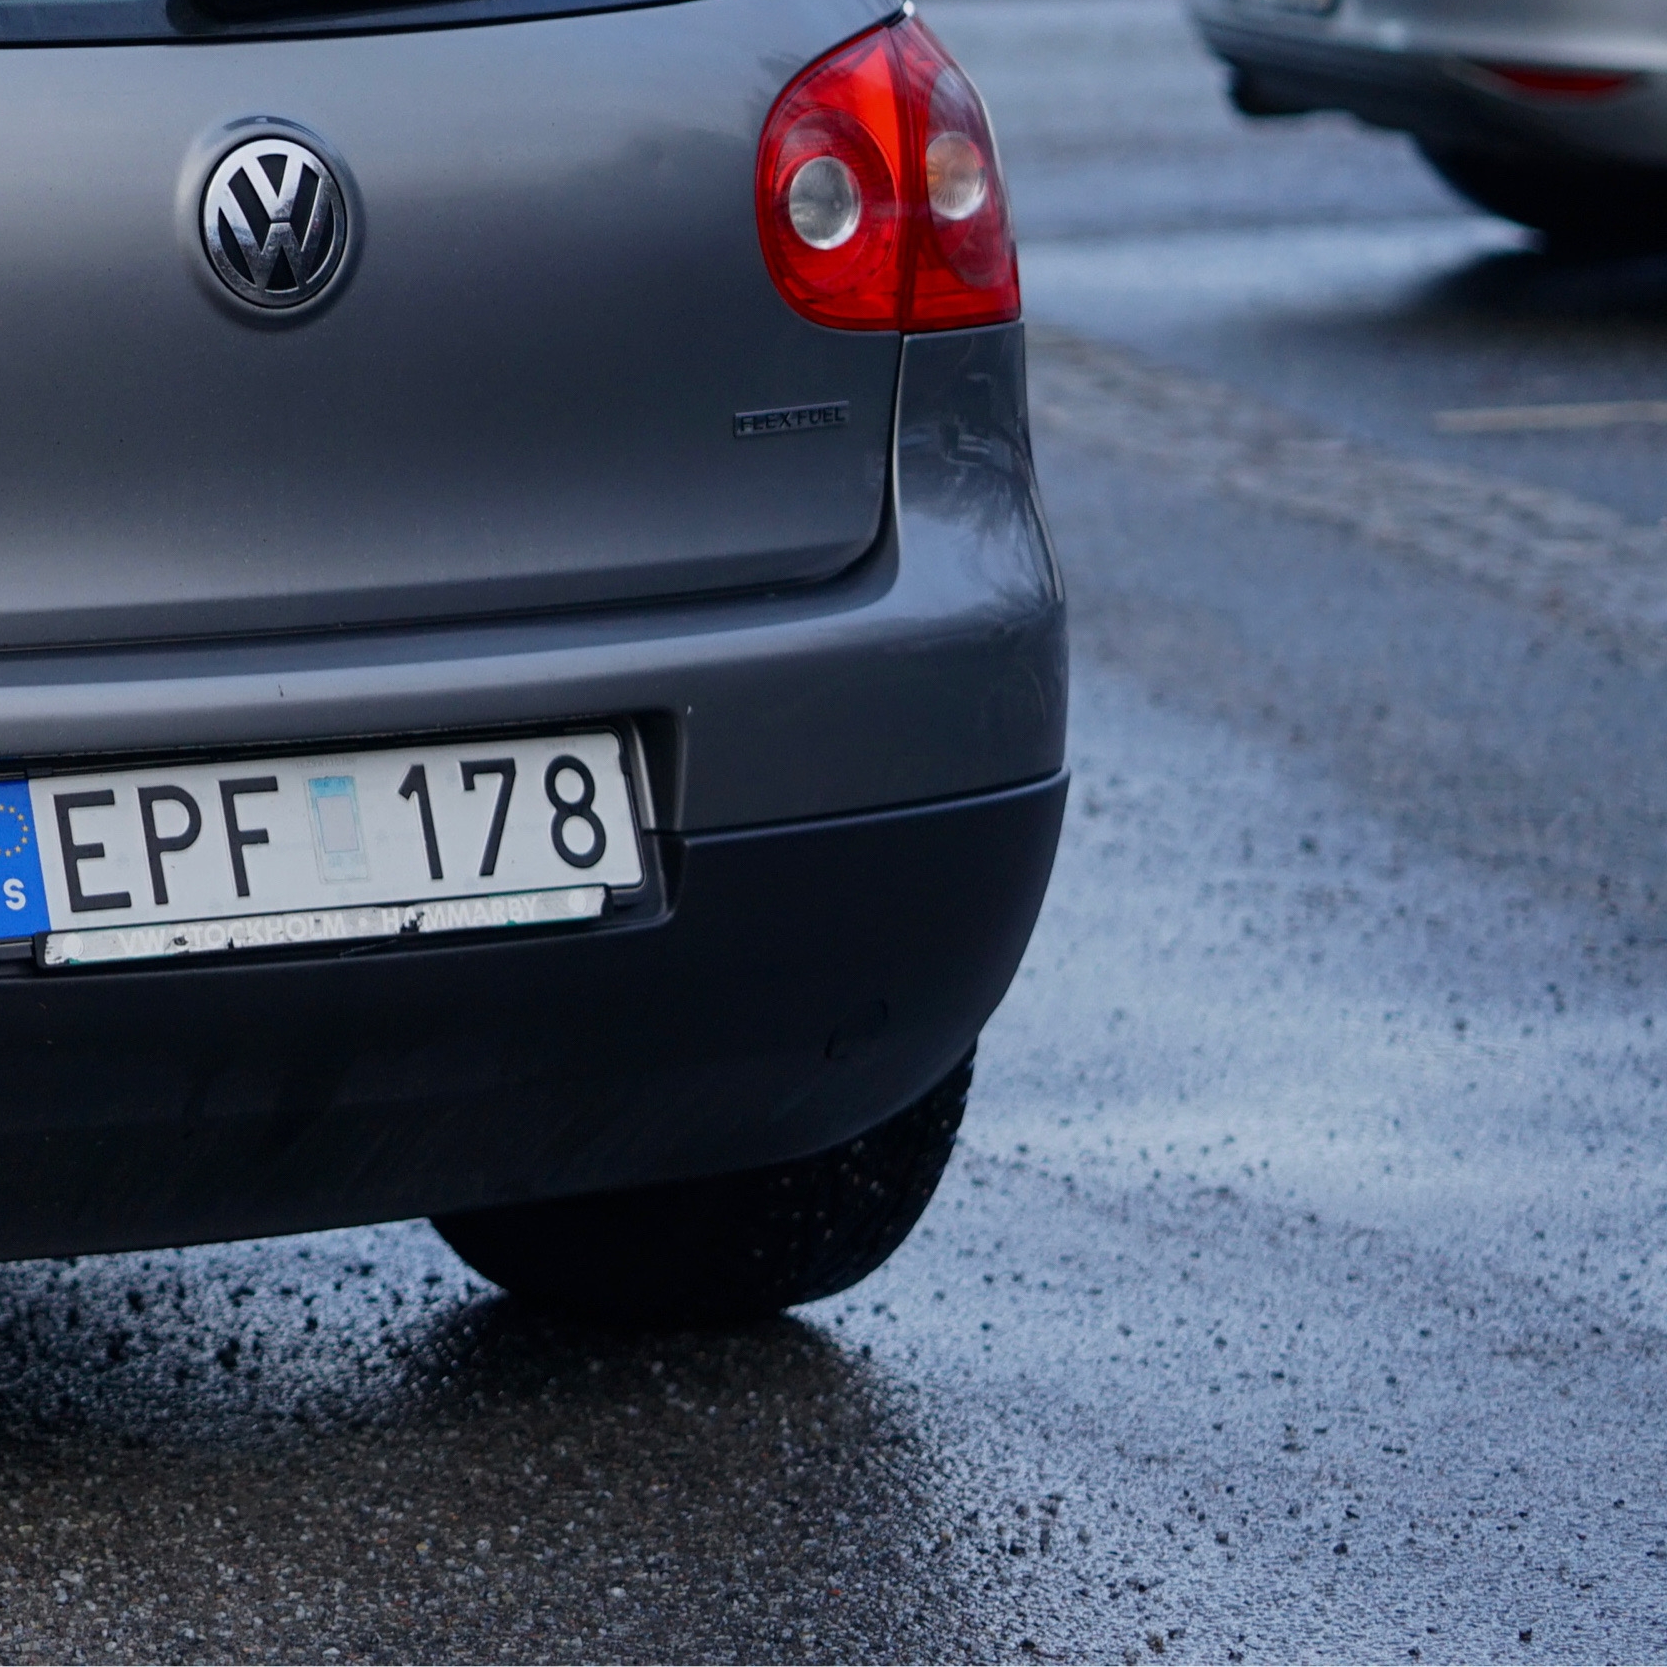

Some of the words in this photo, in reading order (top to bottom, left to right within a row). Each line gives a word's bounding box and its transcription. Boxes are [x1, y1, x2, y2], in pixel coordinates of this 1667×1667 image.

[204, 138, 346, 306] VW
[53, 776, 279, 913] EPF
[398, 754, 607, 880] 178
[3, 878, 27, 911] S
[117, 930, 167, 955] VW
[173, 912, 347, 948] STOCKHOLM
[380, 895, 541, 934] HAMMARBY
